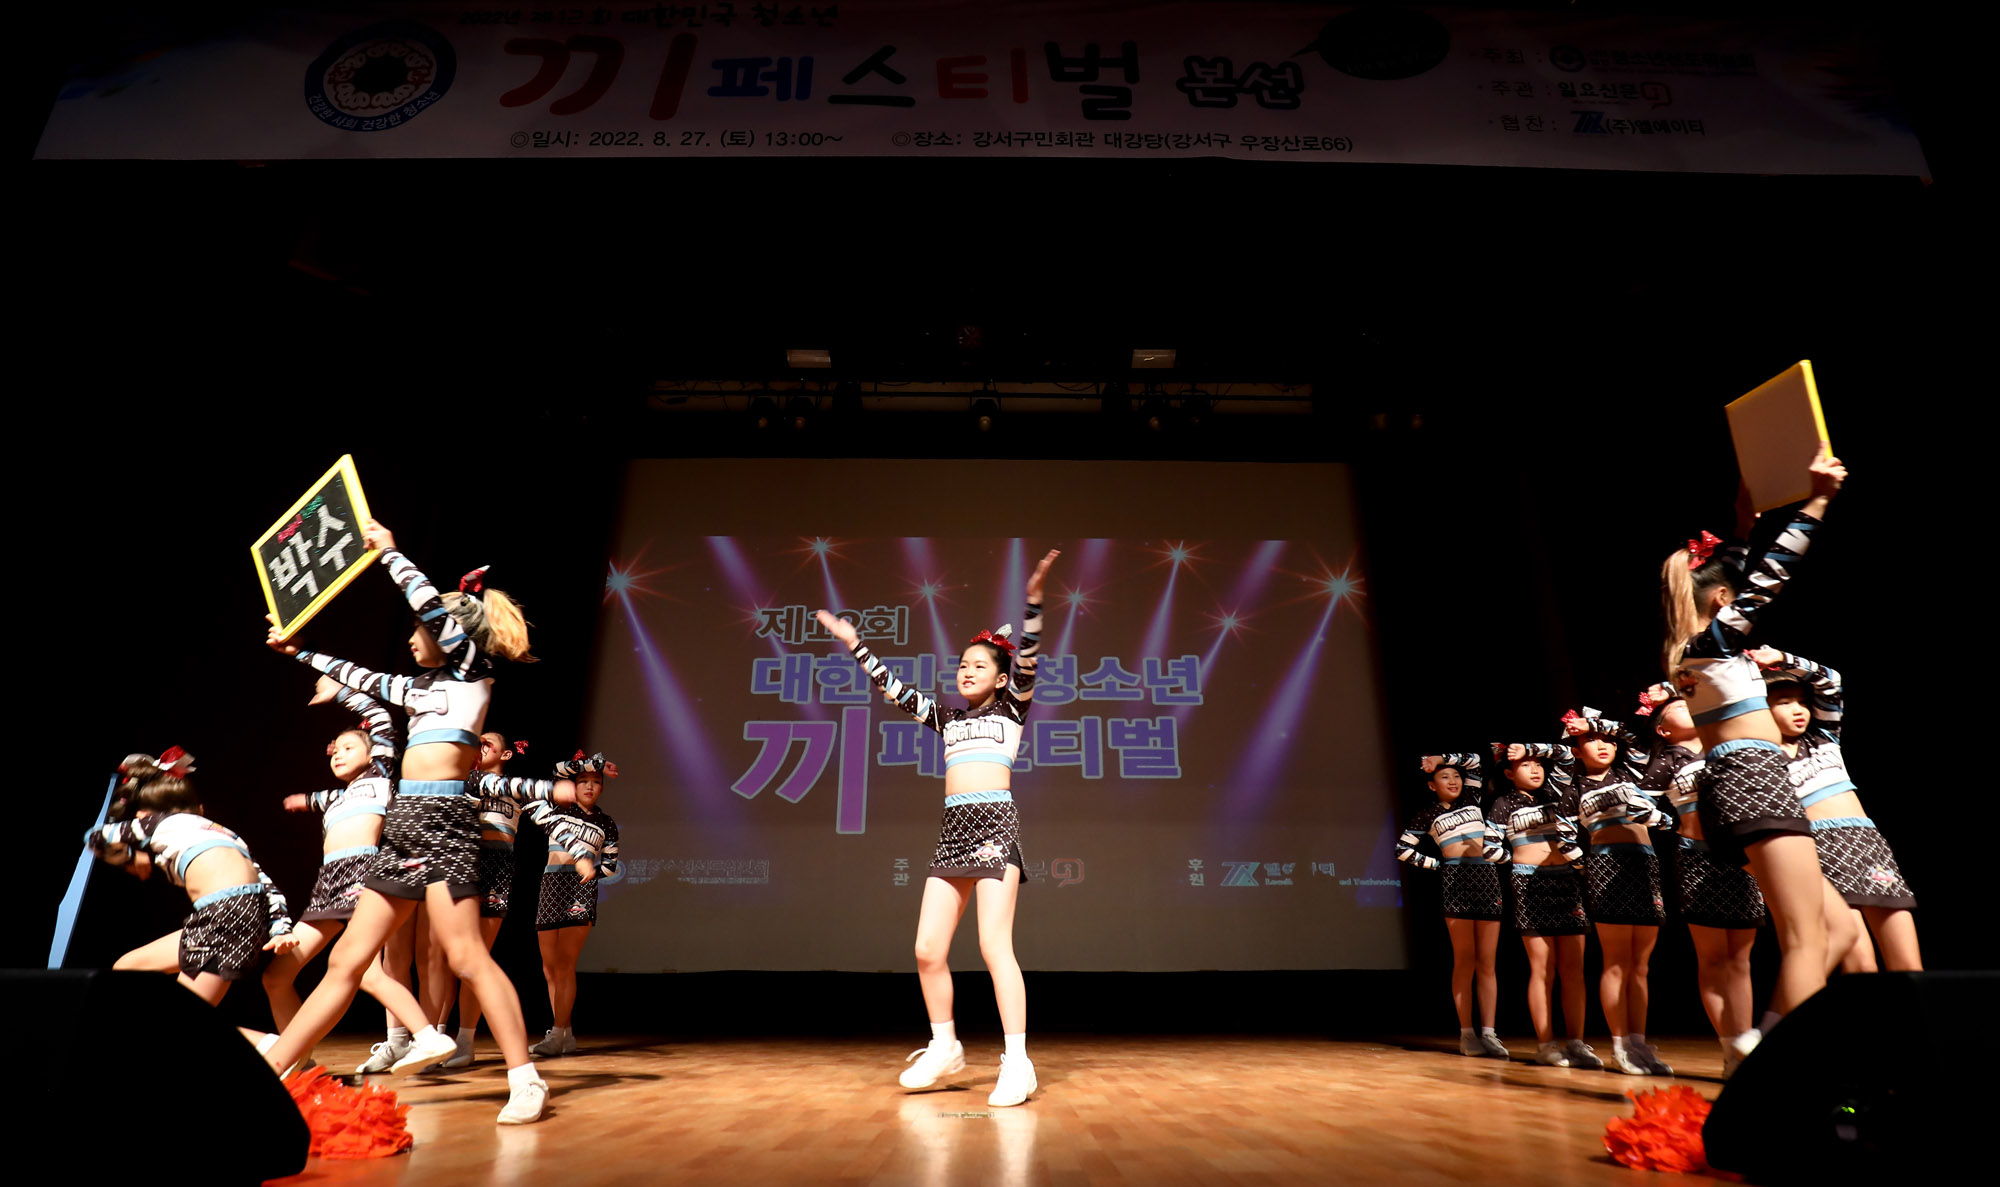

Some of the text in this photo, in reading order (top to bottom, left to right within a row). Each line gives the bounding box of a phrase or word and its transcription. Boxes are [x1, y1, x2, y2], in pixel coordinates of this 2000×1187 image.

[620, 3, 737, 27] 대한민국
[751, 4, 838, 27] 청소년
[1176, 55, 1304, 110] 본선
[1557, 82, 1640, 100] 일요신문
[333, 115, 359, 130] 사회
[362, 111, 402, 130] 건강한
[402, 91, 441, 117] 청소년
[589, 131, 643, 148] 2022.
[652, 131, 671, 148] 8.
[680, 131, 711, 148] 27.
[720, 129, 755, 149] (토)
[973, 131, 1096, 148] 강서구민회관
[1240, 135, 1354, 152] 우장산로66)
[268, 504, 354, 598] 박수
[1032, 653, 1204, 706] 청소년
